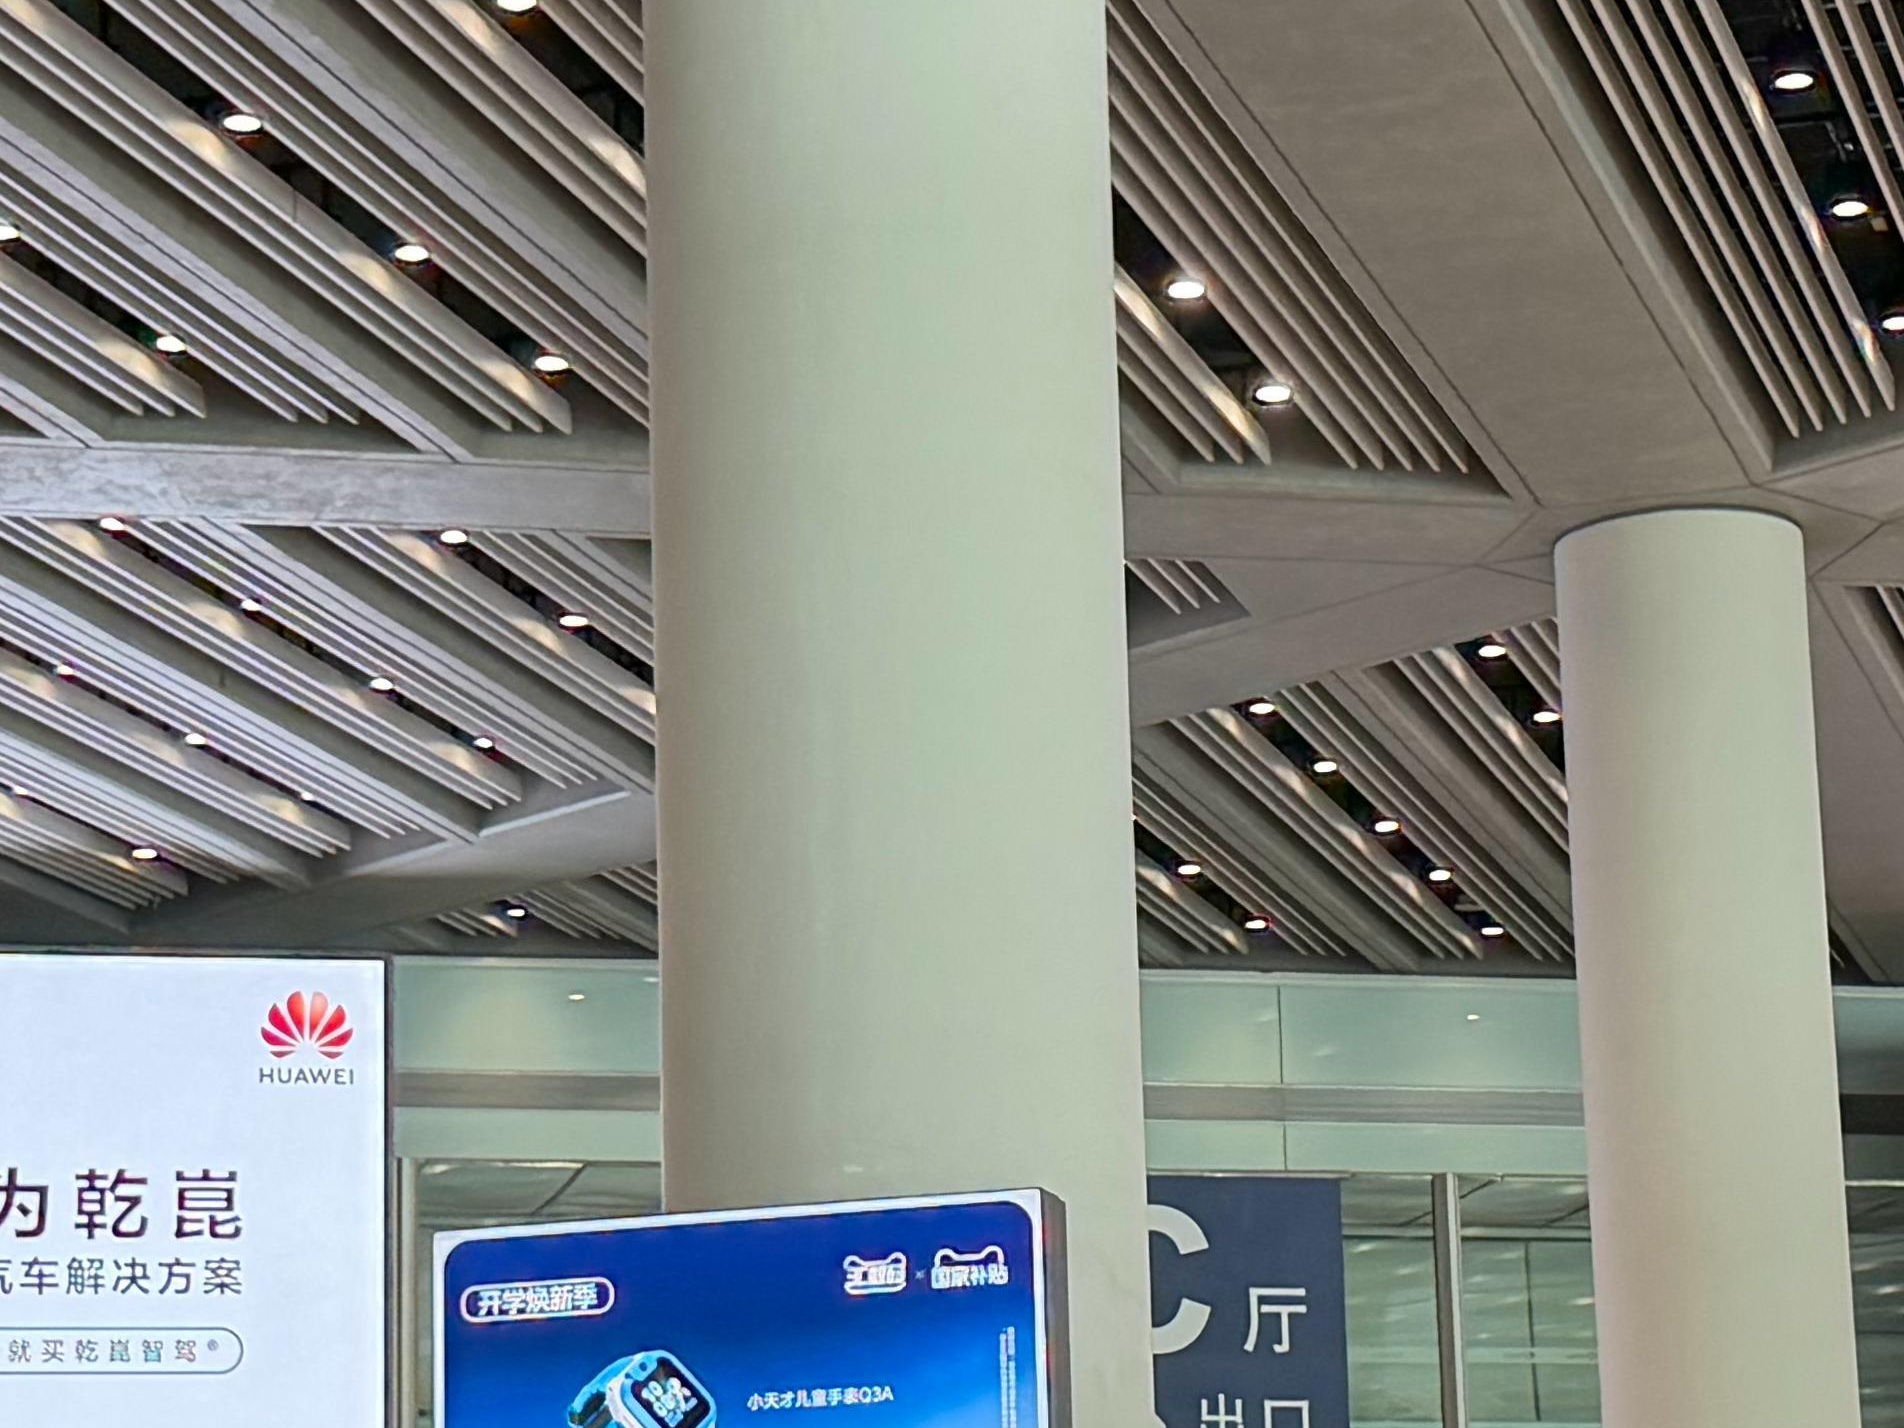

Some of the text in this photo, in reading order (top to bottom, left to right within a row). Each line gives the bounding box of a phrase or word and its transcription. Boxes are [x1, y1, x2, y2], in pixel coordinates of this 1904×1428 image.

[258, 1067, 354, 1085] HUAWEI
[477, 1282, 599, 1317] 开学焕新季
[1243, 1286, 1308, 1354] 厅
